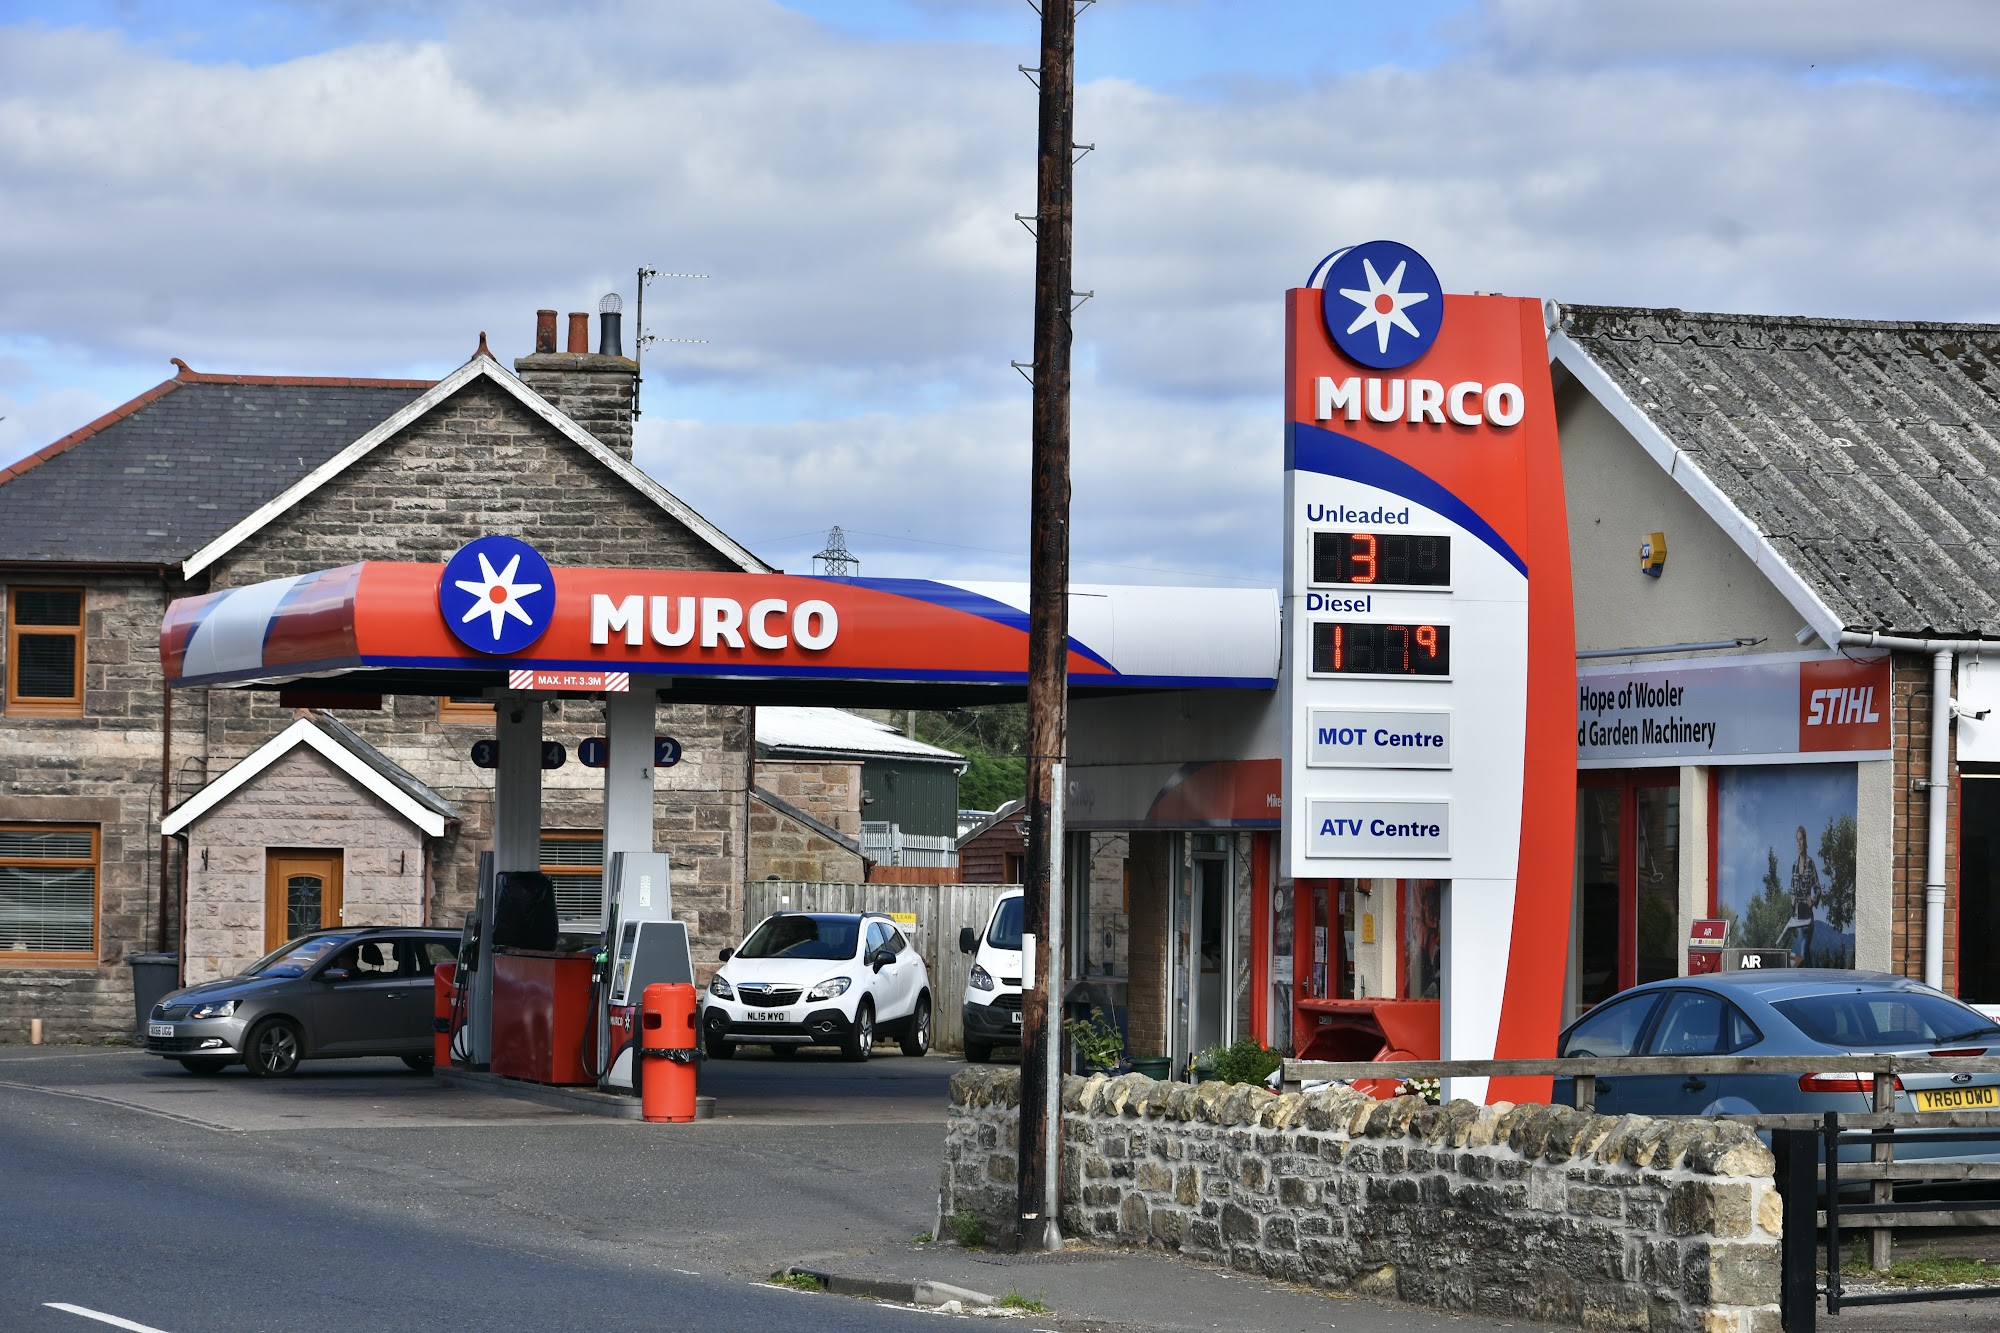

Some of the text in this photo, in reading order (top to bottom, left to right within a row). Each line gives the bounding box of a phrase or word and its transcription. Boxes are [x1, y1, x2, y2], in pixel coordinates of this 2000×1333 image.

[1315, 376, 1525, 427] MURCO
[1307, 504, 1409, 524] Unleaded
[1307, 593, 1371, 612] Diesel
[590, 594, 839, 650] MURCO
[538, 676, 601, 686] MAX. HT. 3.3M
[1580, 680, 1684, 716] Hope of Wooler
[1807, 686, 1880, 725] STIHL
[1318, 728, 1444, 747] MOT Centre
[1589, 719, 1638, 746] Garden
[1642, 716, 1716, 749] Machinery
[479, 745, 490, 763] 3
[547, 745, 559, 764] 4
[589, 743, 595, 762] 1
[661, 743, 674, 763] 2
[1320, 819, 1440, 837] ATV Centre
[1703, 927, 1713, 936] AIR
[1741, 955, 1761, 968] AIR
[747, 1012, 765, 1020] NL15
[1924, 1089, 1993, 1108] YR60 OWO
